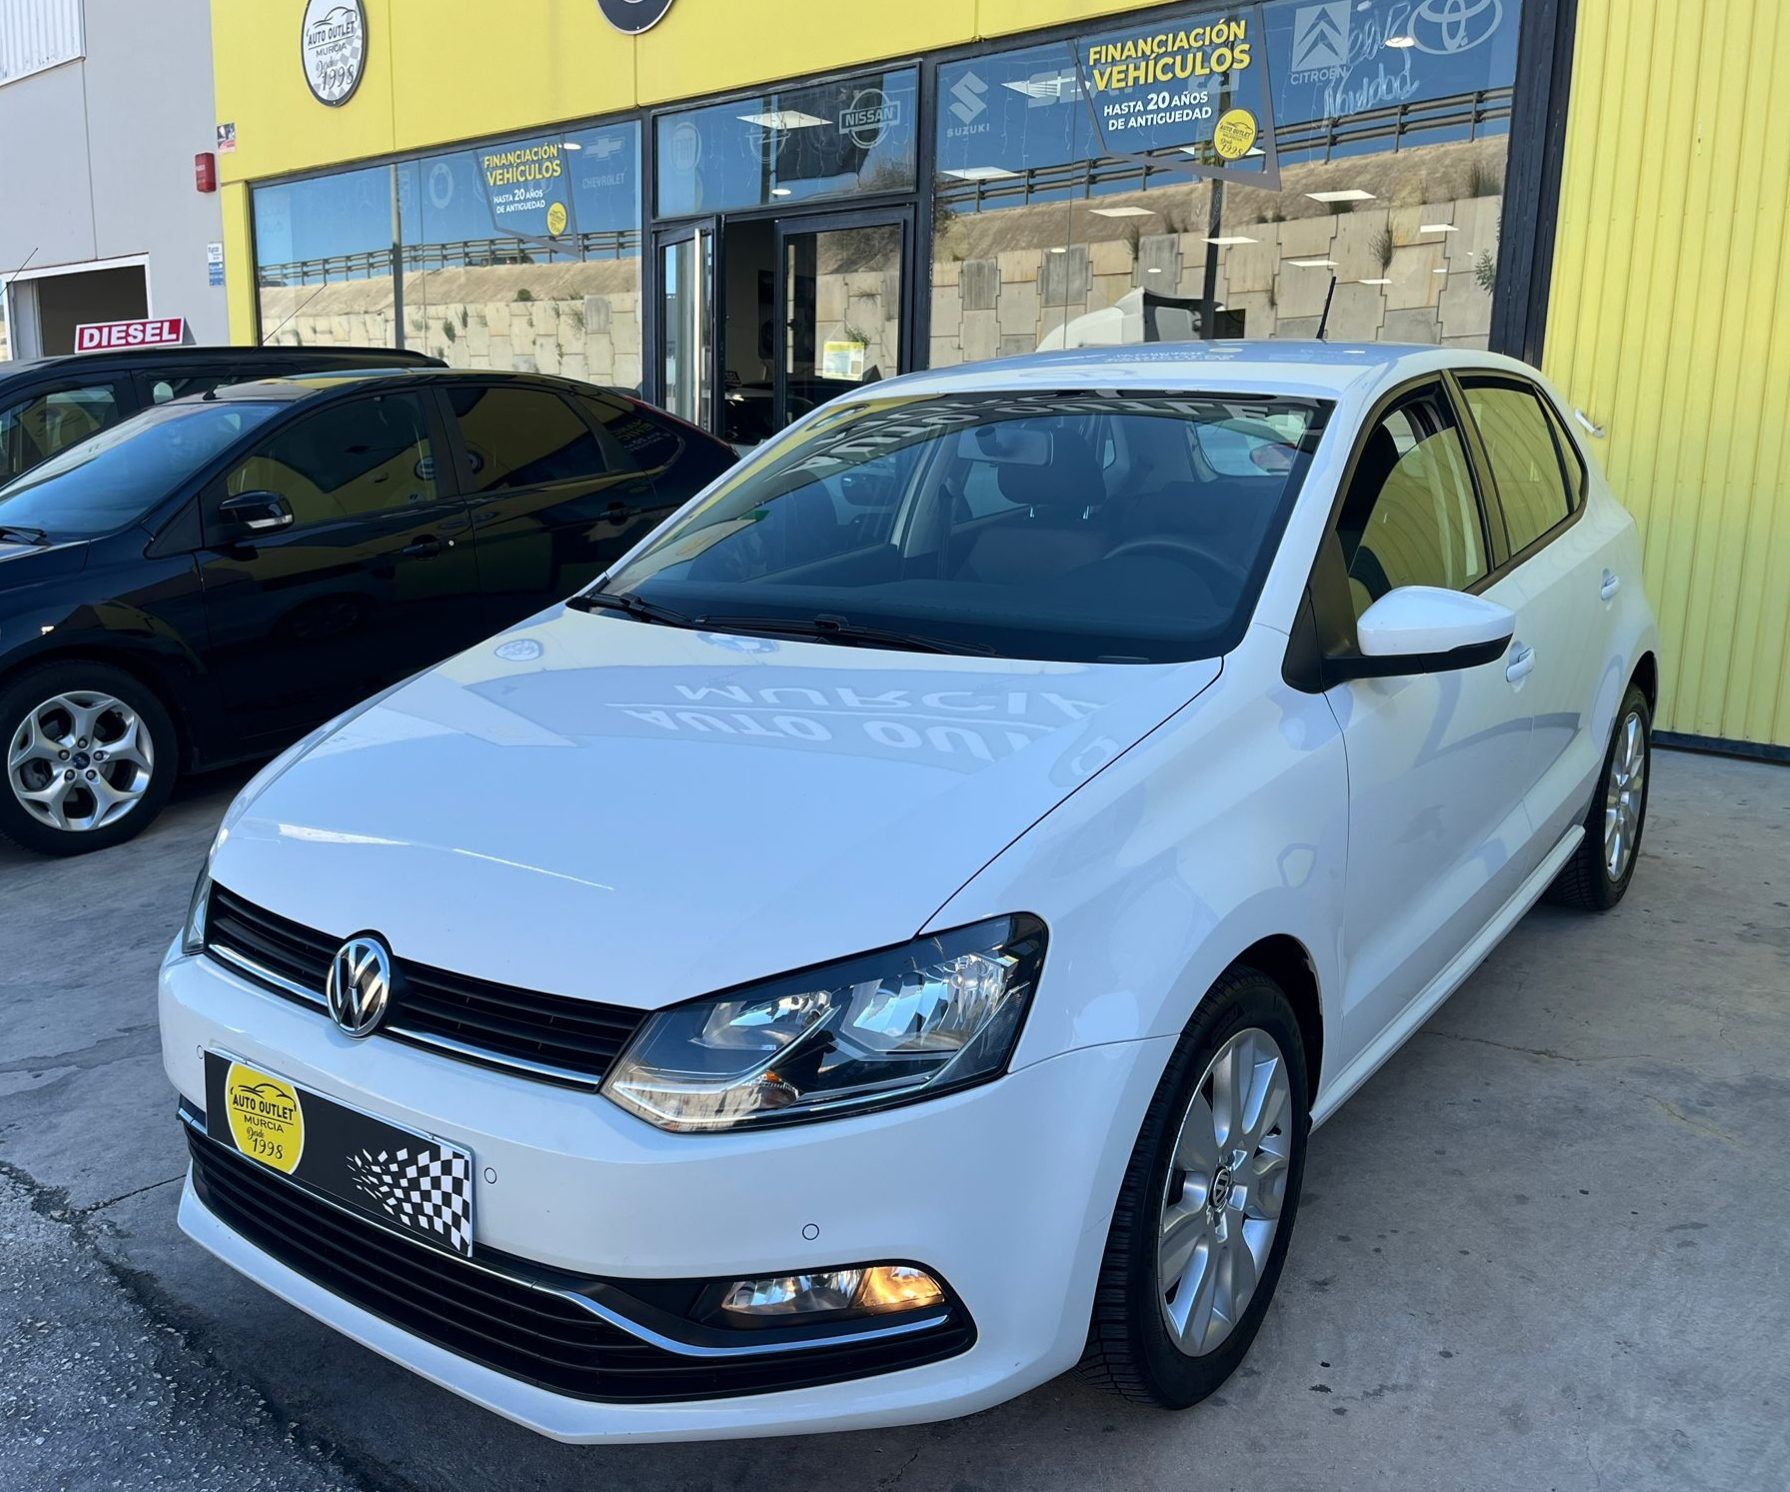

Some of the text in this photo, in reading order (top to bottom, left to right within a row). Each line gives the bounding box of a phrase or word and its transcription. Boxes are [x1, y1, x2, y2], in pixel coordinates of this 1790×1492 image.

[308, 21, 355, 46] AUTO OUTLET
[1088, 18, 1246, 65] FINANCIACIÓN
[316, 42, 347, 57] MURCIA
[322, 64, 354, 91] 1998
[1092, 43, 1251, 91] VEHÍCULOS
[1103, 90, 1209, 117] HASTA 20 AÑOS
[845, 107, 894, 127] NISSAN
[1108, 106, 1212, 131] DE ANTIGUEDAD
[946, 123, 990, 138] SUZUKI
[484, 142, 558, 169] FINANCIACIÓN
[487, 160, 562, 186] VEHÍCULOS
[582, 173, 625, 189] CHEVROLET
[493, 188, 543, 205] HASTA 20 AÑOS
[496, 199, 546, 214] DE ANTIGUEDAD
[82, 321, 177, 348] DIESEL
[233, 1094, 294, 1121] AUTO OUTLET
[244, 1114, 285, 1134] MURCIA
[253, 1137, 284, 1160] 1998
